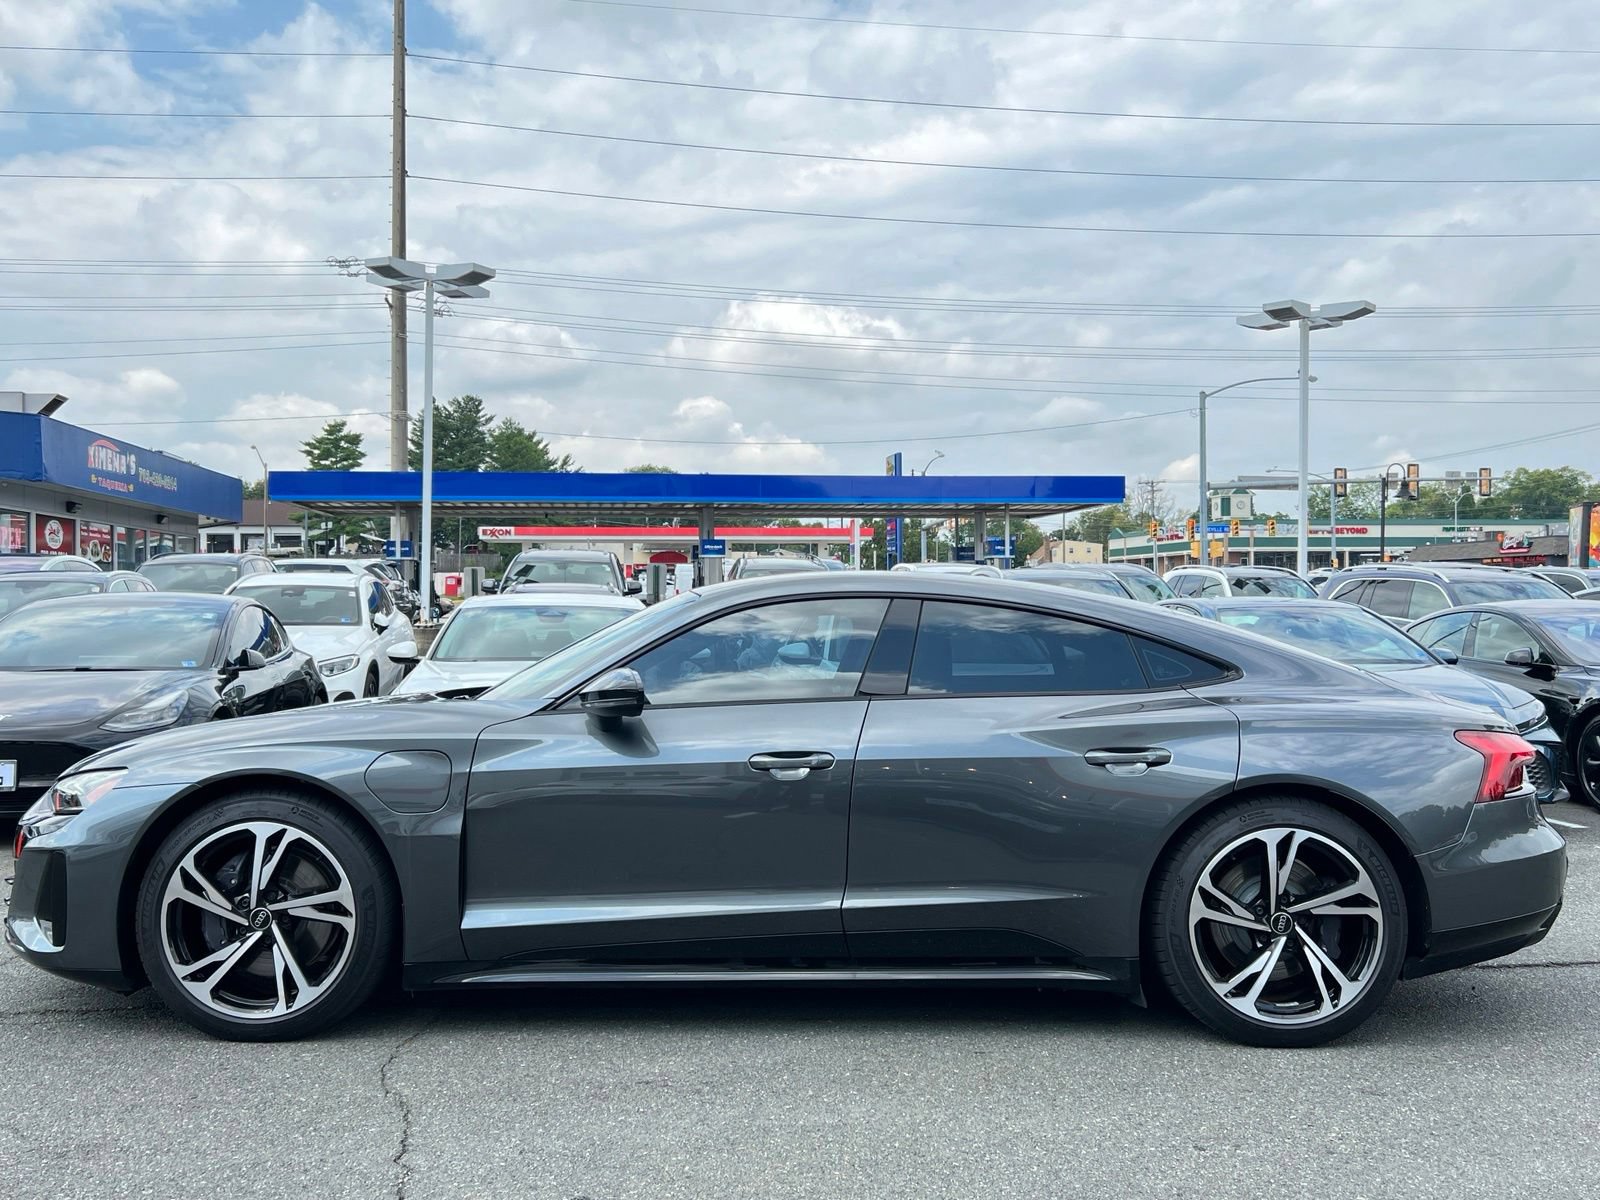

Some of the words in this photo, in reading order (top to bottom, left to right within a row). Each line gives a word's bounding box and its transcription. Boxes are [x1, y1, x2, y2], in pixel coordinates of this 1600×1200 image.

[87, 446, 136, 475] XIMENA'S
[481, 527, 512, 539] EXXON
[1334, 527, 1368, 535] BEYOND
